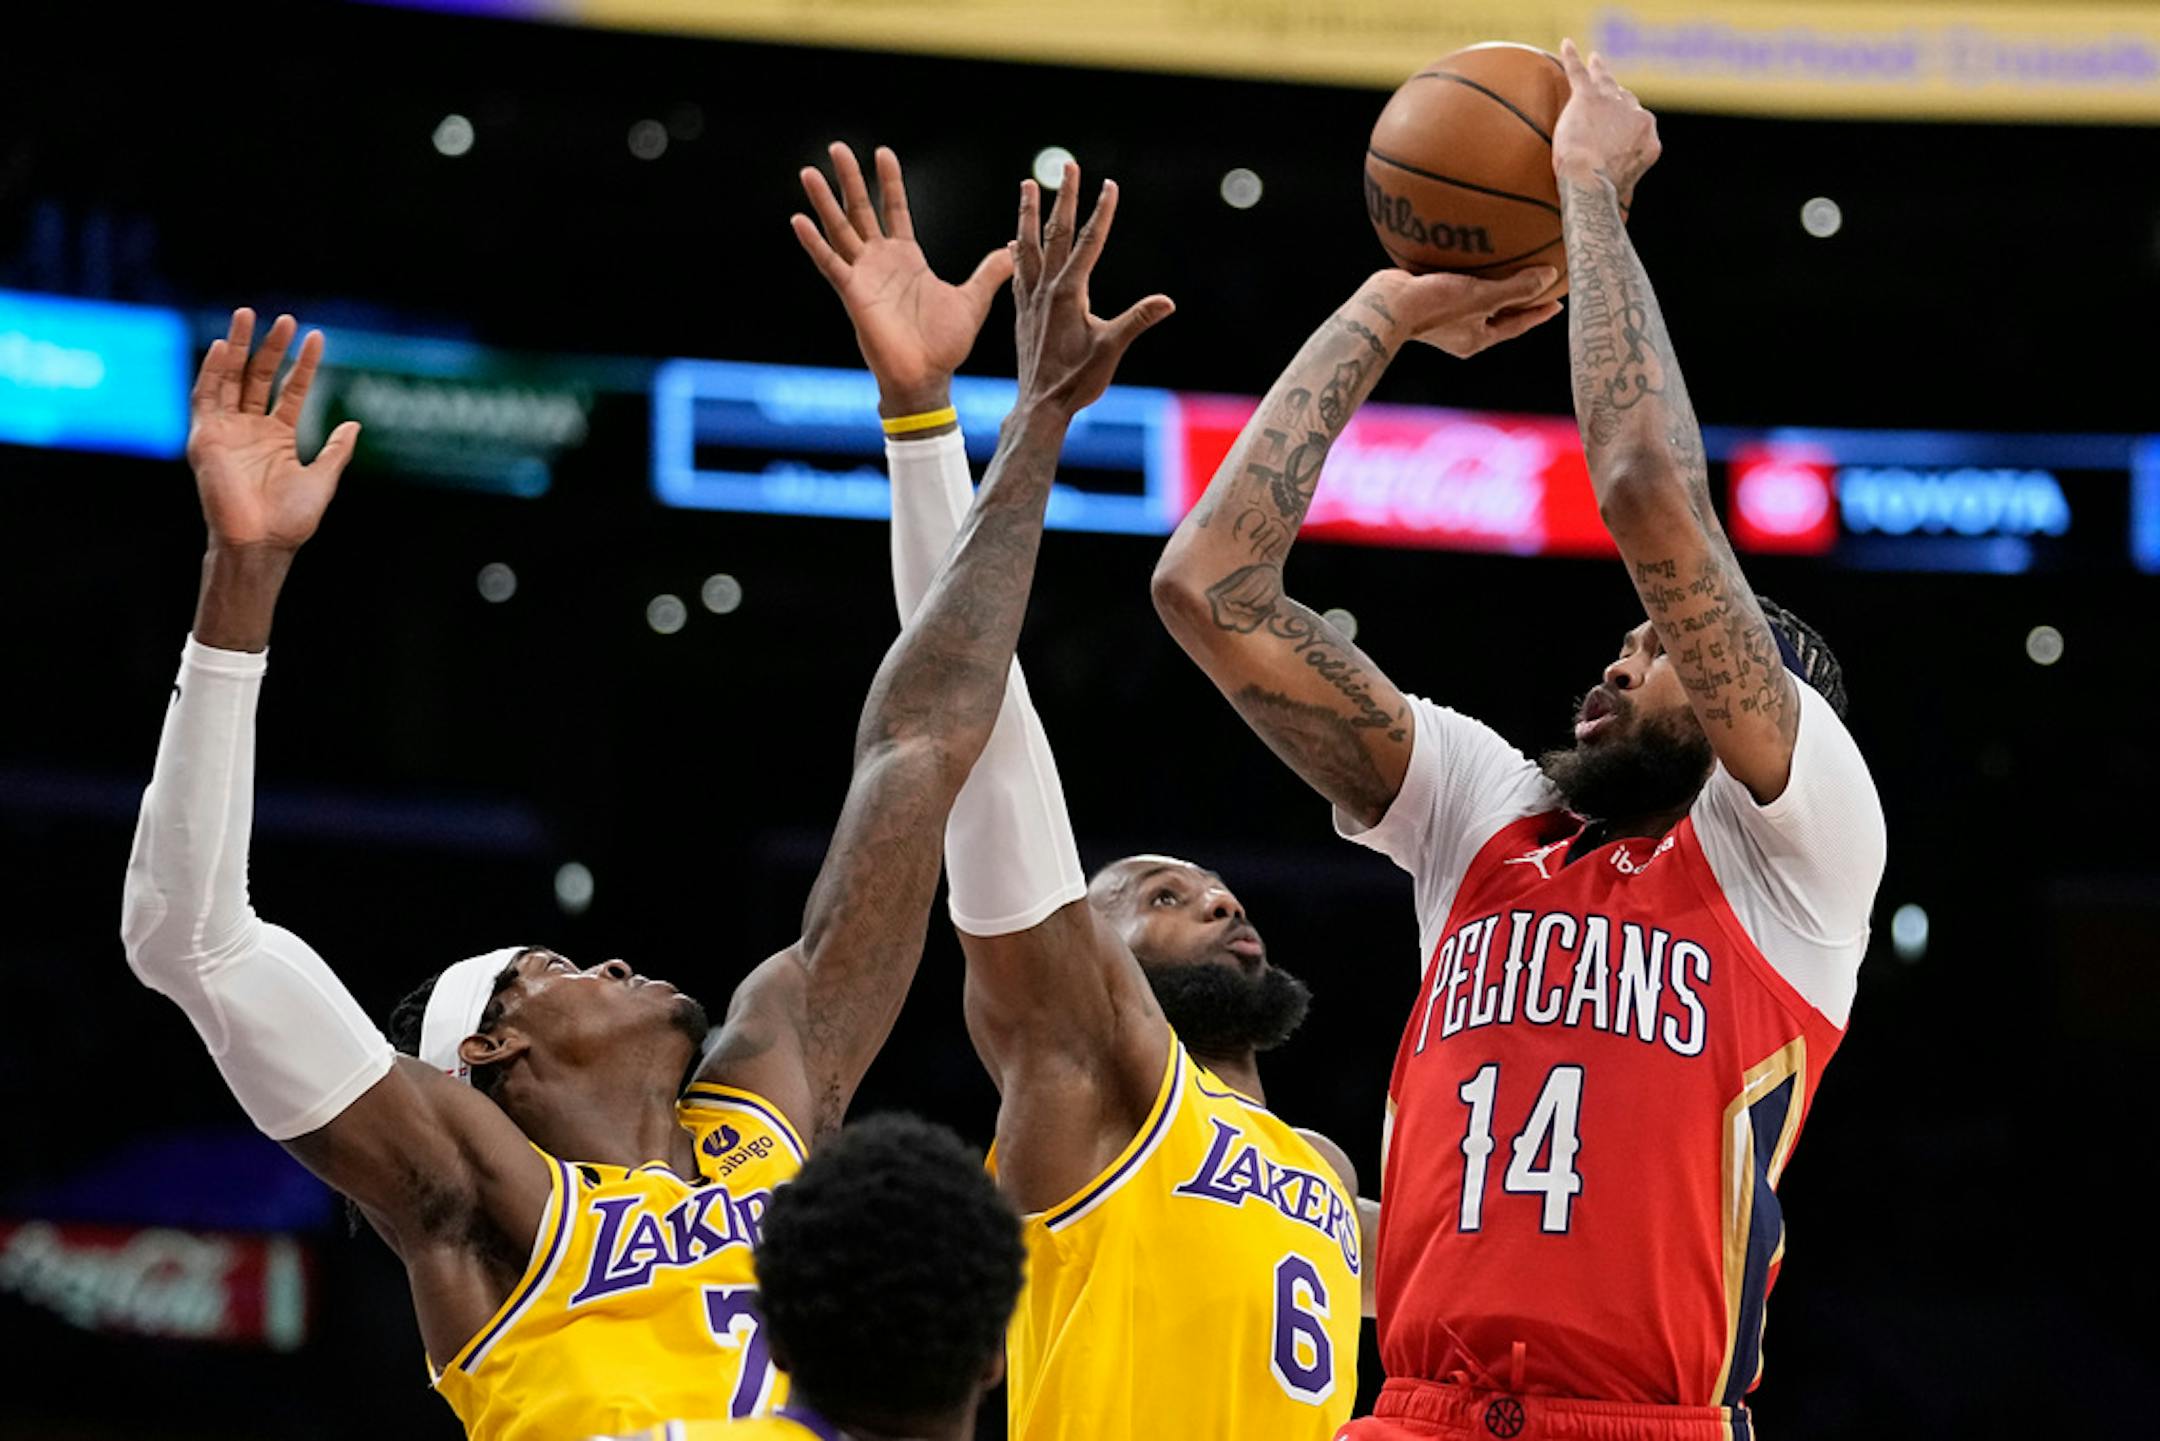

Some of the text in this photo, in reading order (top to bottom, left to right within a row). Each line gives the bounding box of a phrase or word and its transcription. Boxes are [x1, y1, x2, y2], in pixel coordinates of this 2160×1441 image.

[1837, 468, 2070, 536] TOYOTA
[1414, 909, 1712, 1057] PELICANS
[1171, 1116, 1362, 1275] LAKERS
[1458, 1063, 1585, 1234] 14
[701, 1284, 776, 1423] 7
[1270, 1251, 1336, 1406] 6
